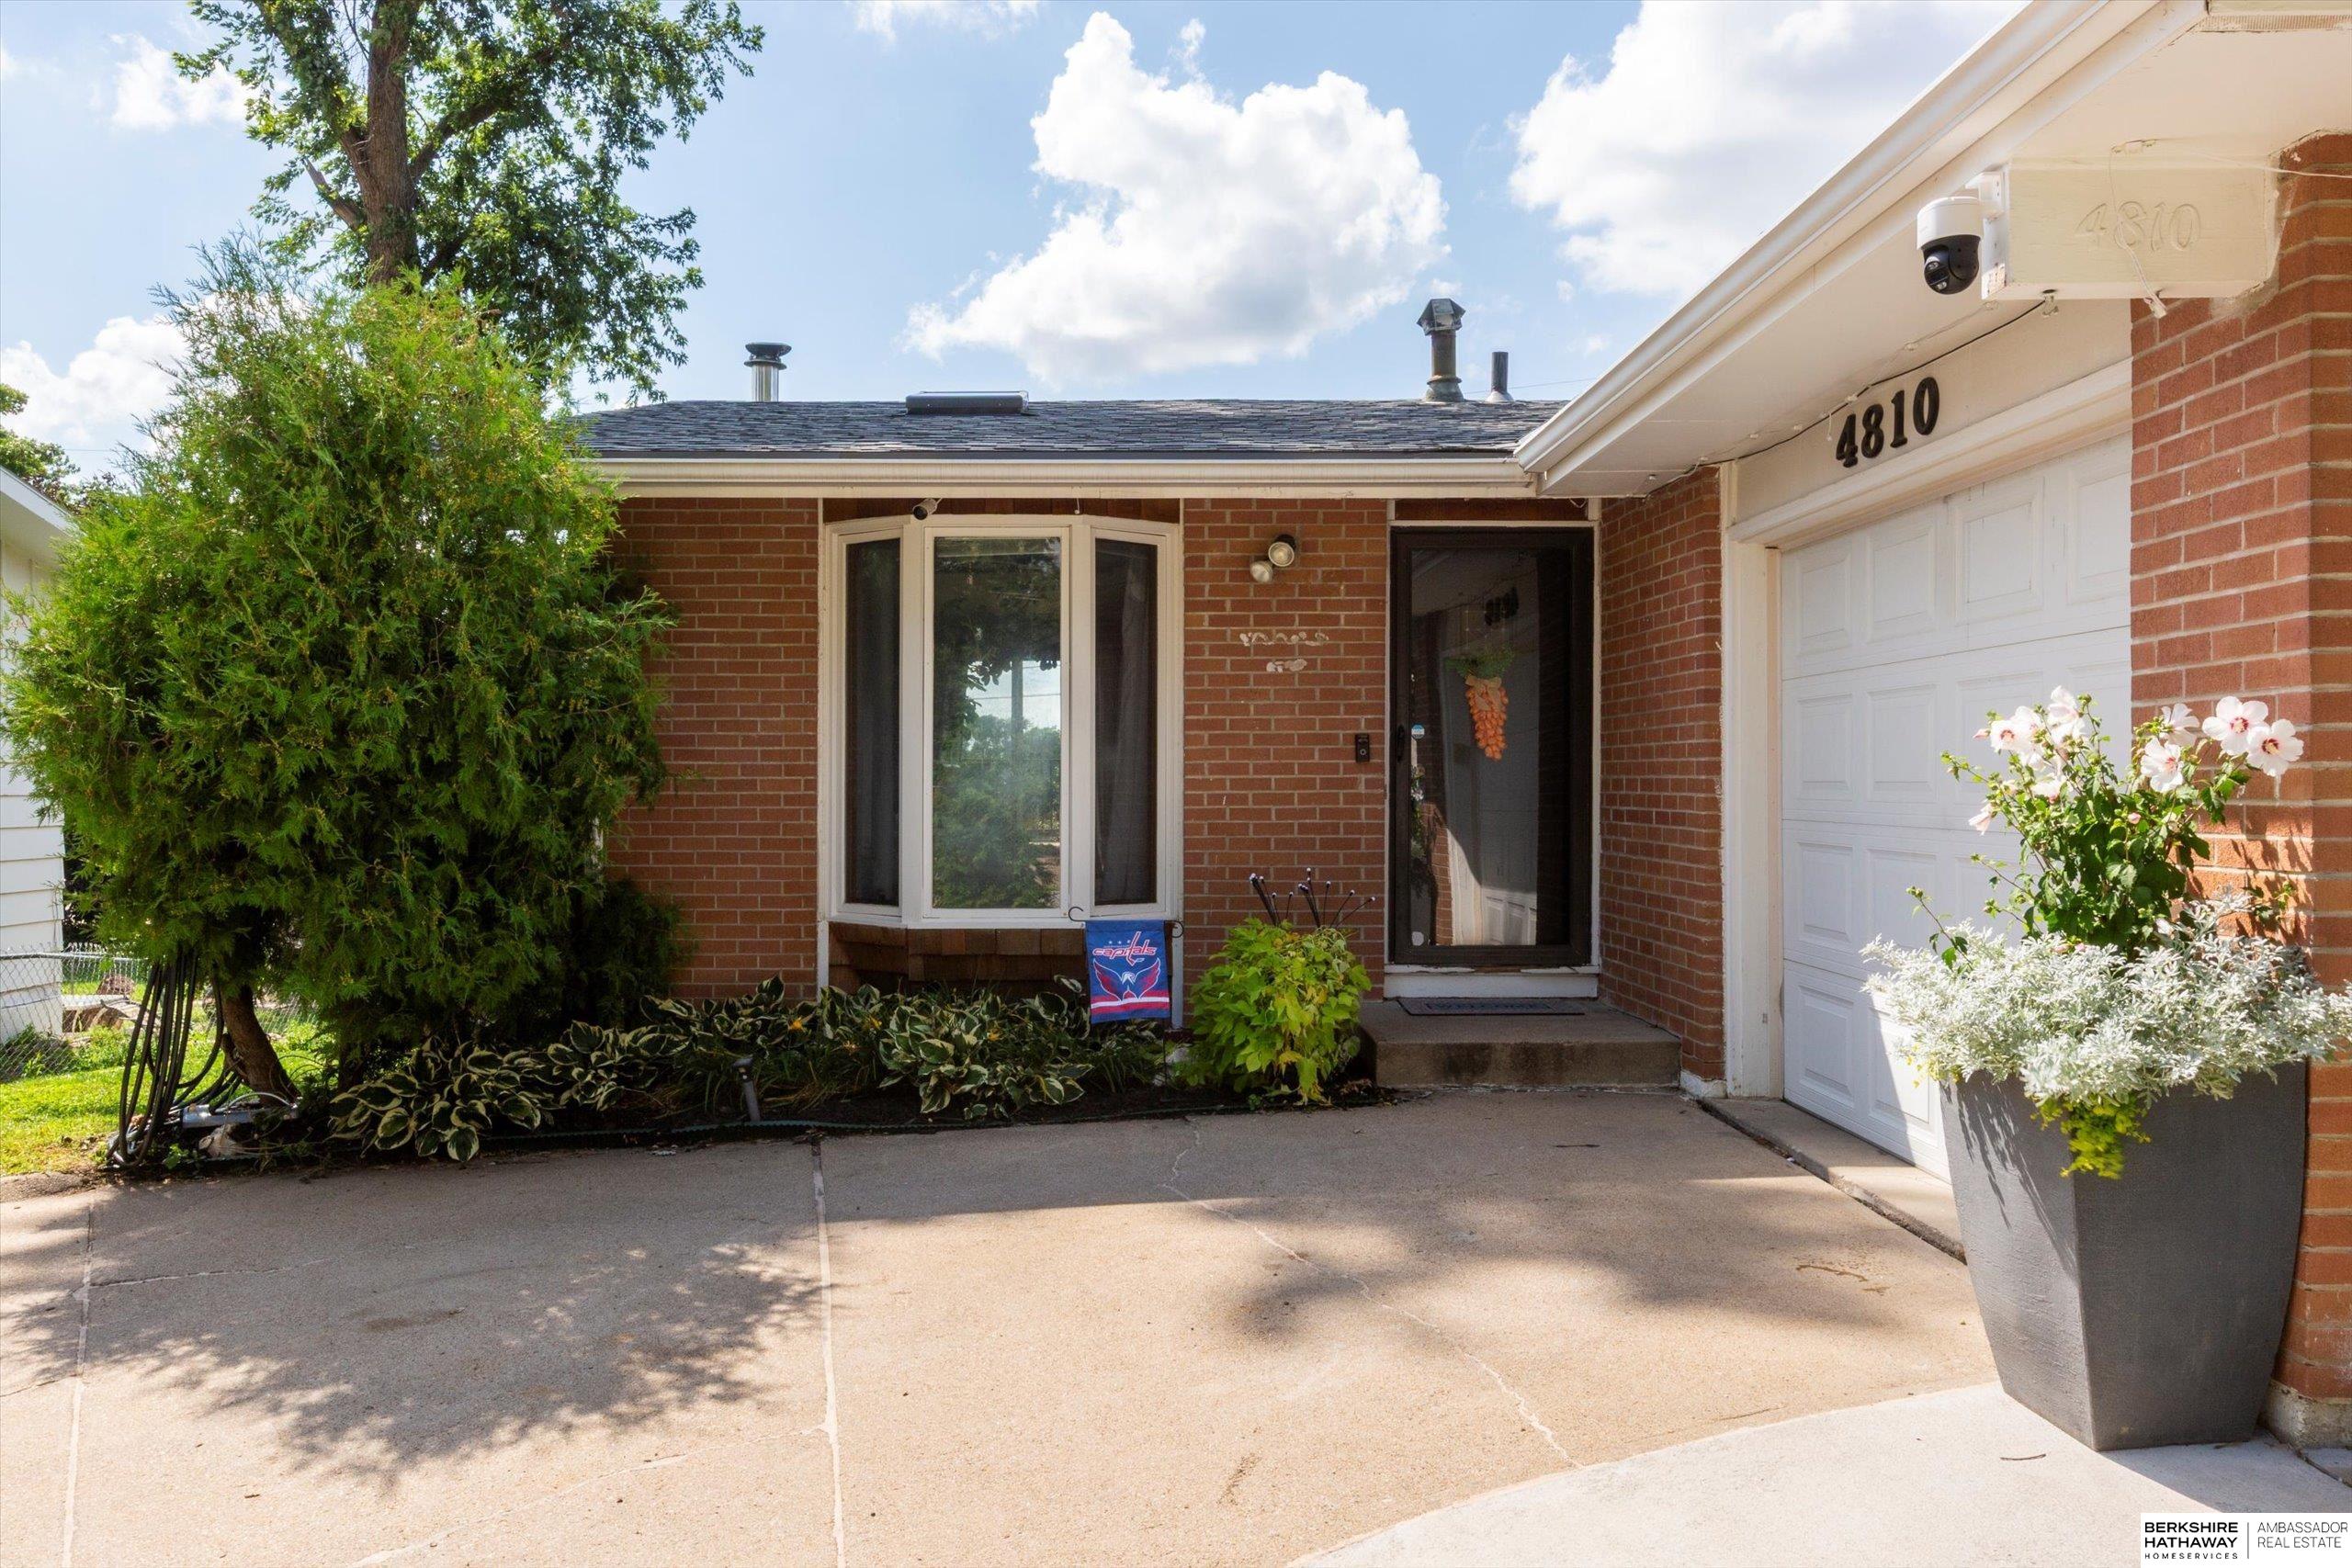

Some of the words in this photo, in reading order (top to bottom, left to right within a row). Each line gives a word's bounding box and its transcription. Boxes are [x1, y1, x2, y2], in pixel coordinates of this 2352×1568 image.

[2075, 200, 2202, 253] 4810
[1836, 377, 1939, 468] 4810
[1092, 931, 1157, 966] capitals
